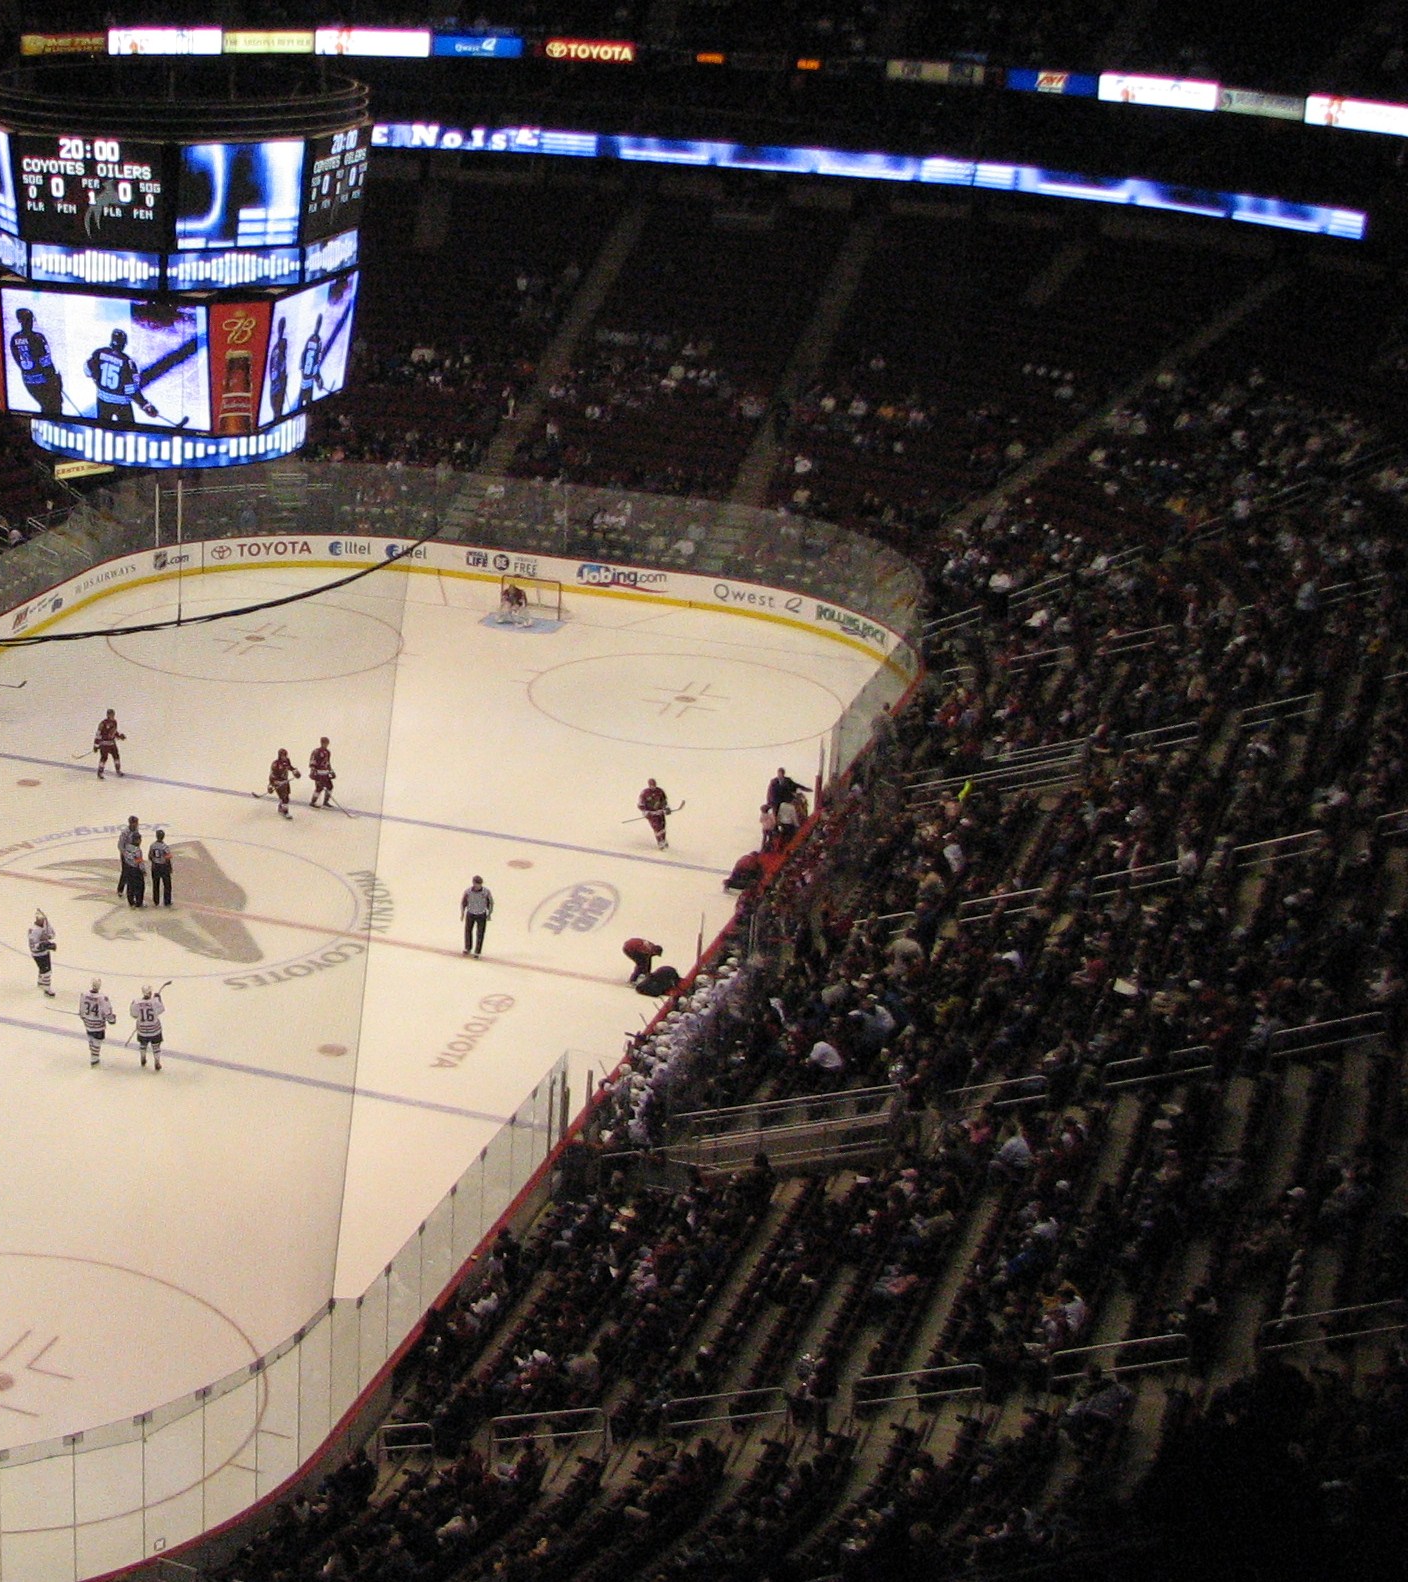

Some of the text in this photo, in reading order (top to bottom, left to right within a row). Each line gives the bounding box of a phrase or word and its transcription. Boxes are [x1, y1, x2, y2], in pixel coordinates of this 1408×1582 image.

[568, 44, 633, 61] TOYOTA
[59, 138, 120, 162] 20:00
[22, 158, 152, 180] COYOTES OILERS
[22, 175, 161, 203] SOG 0 PER 0 SOG
[28, 185, 154, 207] 0 1 0
[99, 361, 120, 390] 15
[236, 541, 312, 558] TOYOTA
[466, 555, 488, 568] LIFE
[514, 562, 537, 577] FREE
[95, 564, 137, 585] AIRWAYS
[577, 564, 668, 587] Jobing.com
[713, 583, 775, 608] Qwest
[223, 943, 366, 990] COYOTES
[83, 1001, 99, 1017] 34
[140, 1008, 154, 1022] 16
[429, 1016, 499, 1068] TOYOTA
